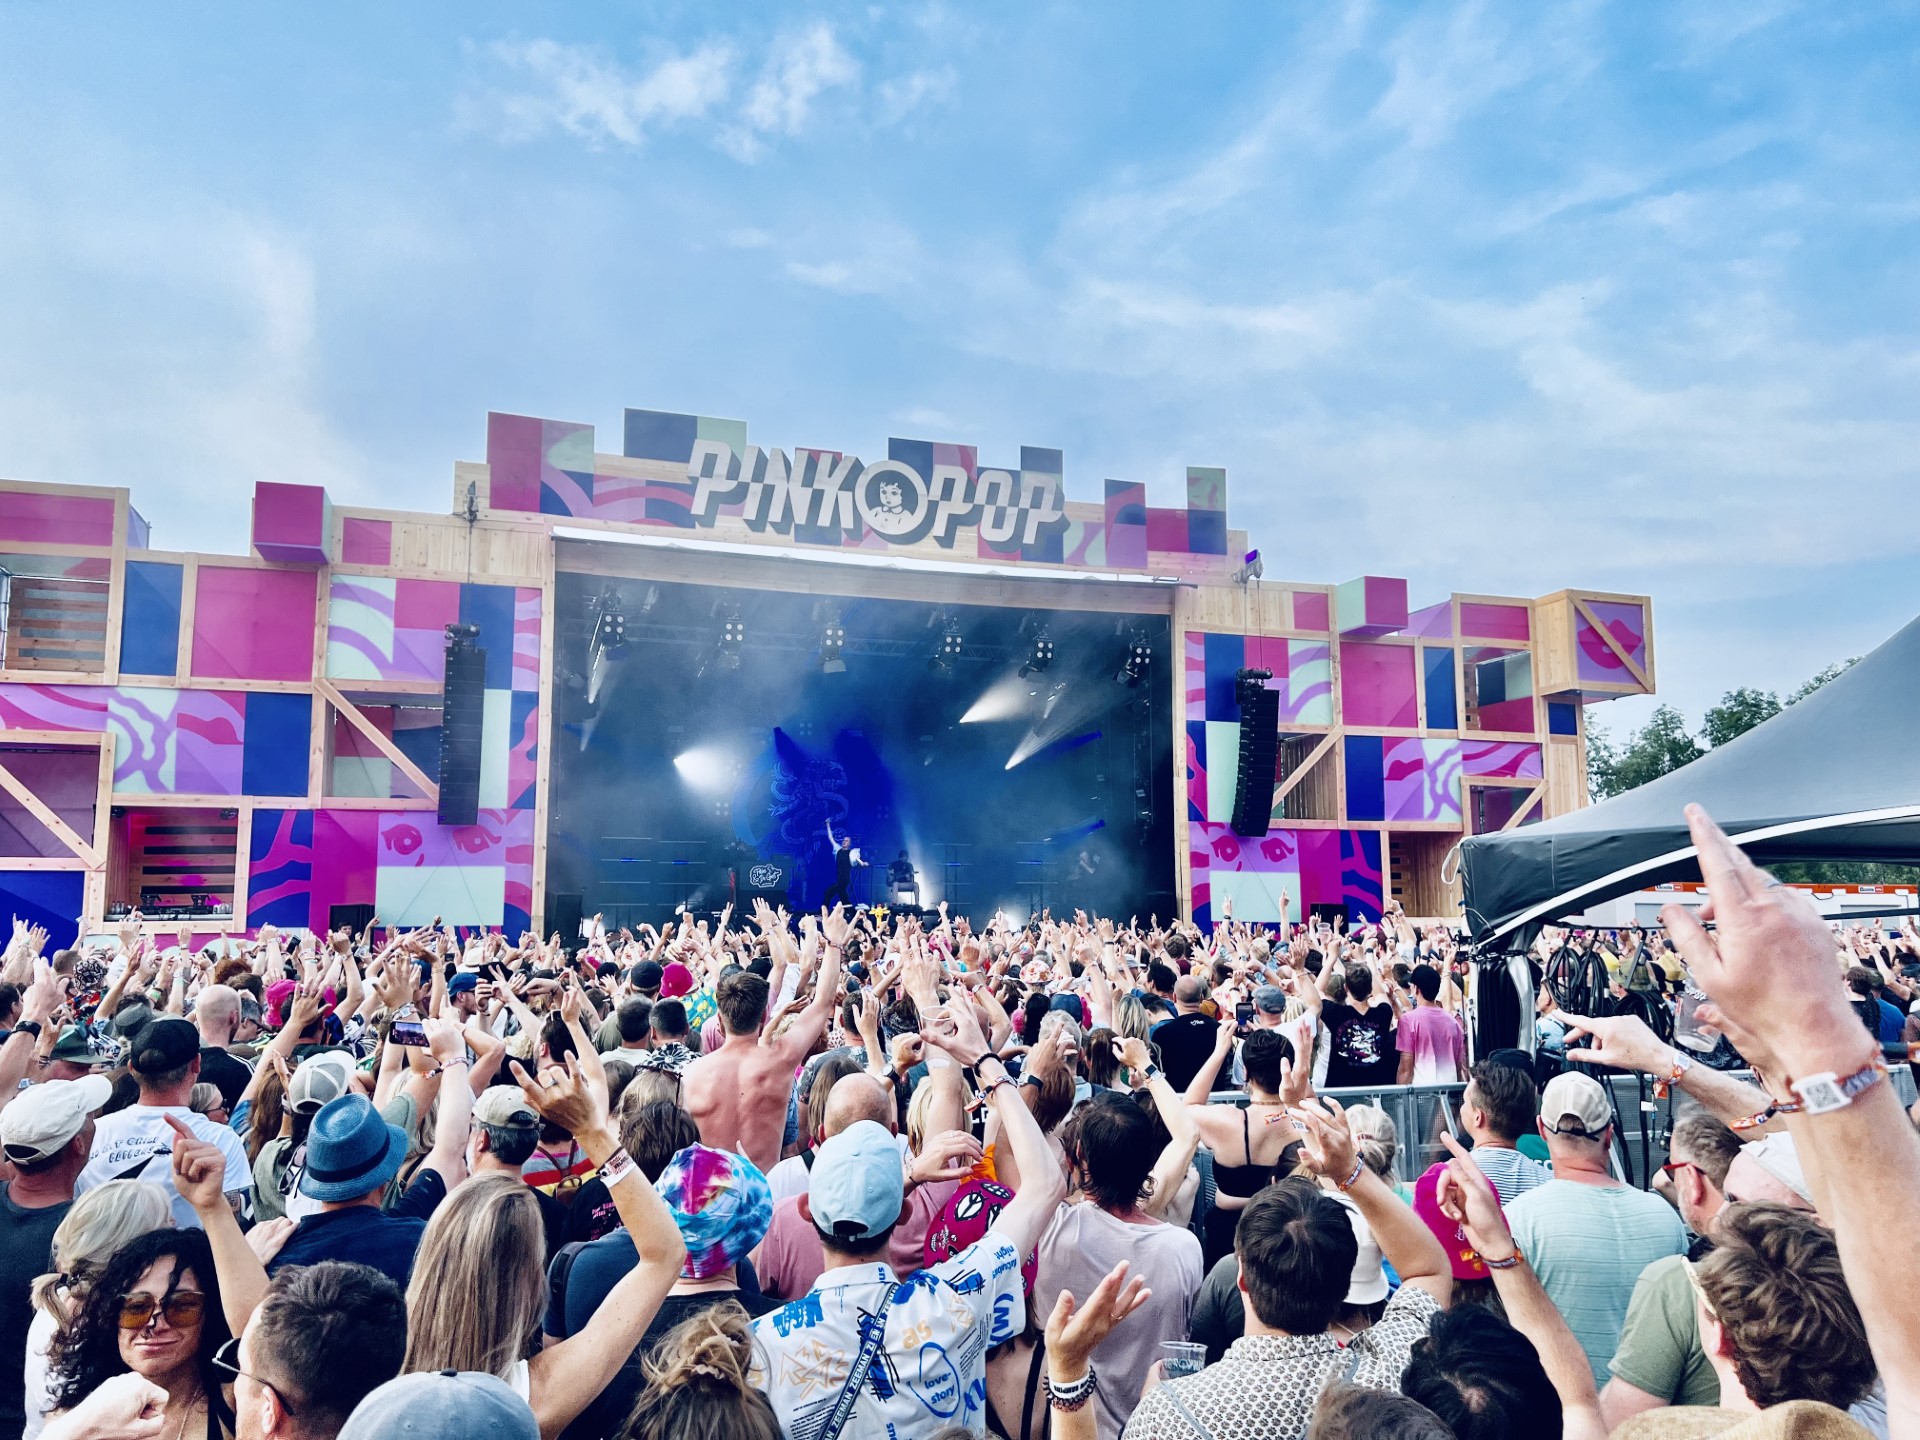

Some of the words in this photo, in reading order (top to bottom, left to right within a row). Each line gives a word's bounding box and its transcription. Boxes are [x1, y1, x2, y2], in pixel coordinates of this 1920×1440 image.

[832, 1391, 853, 1428] ZEEMAN
[849, 1352, 870, 1390] ZEEMAN
[931, 1384, 955, 1405] story
